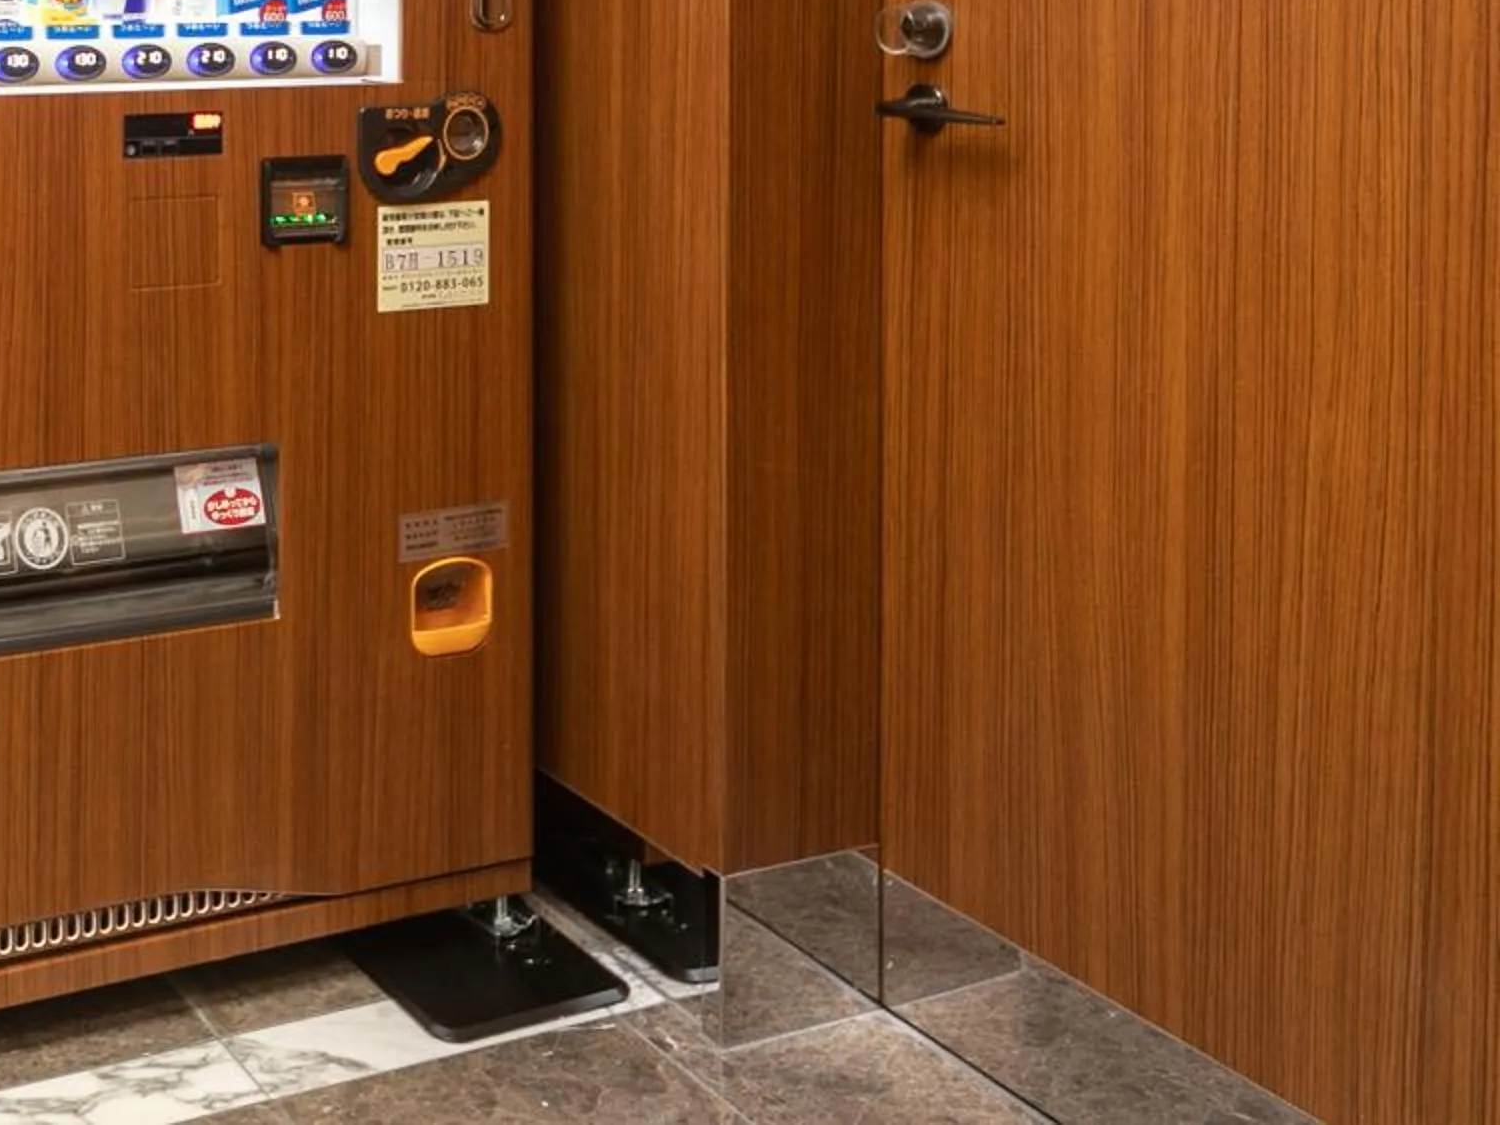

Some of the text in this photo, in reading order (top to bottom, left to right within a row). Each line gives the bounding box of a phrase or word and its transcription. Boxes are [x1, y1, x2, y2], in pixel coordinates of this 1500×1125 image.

[136, 50, 163, 65] 210
[200, 49, 226, 64] 210
[267, 48, 288, 62] 110
[328, 46, 348, 60] 110
